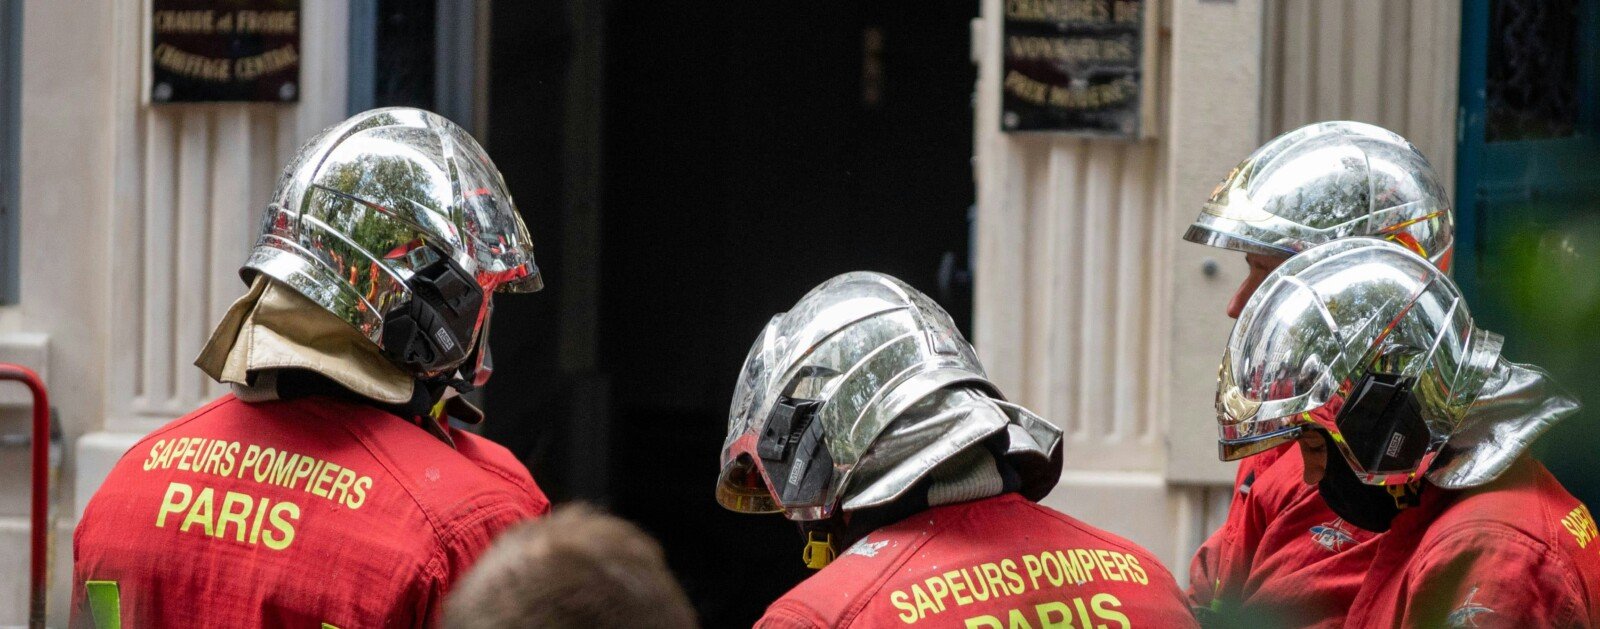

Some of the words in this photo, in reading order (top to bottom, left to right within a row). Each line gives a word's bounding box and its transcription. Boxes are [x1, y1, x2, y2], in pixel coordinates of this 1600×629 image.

[437, 328, 454, 350] MSA
[143, 437, 240, 477] SAPEURS
[238, 444, 373, 509] POMPIERS
[1387, 432, 1402, 457] MSA
[155, 482, 300, 551] PARIS
[890, 559, 1026, 624] SAPEURS
[1022, 548, 1150, 592] POMPIERS
